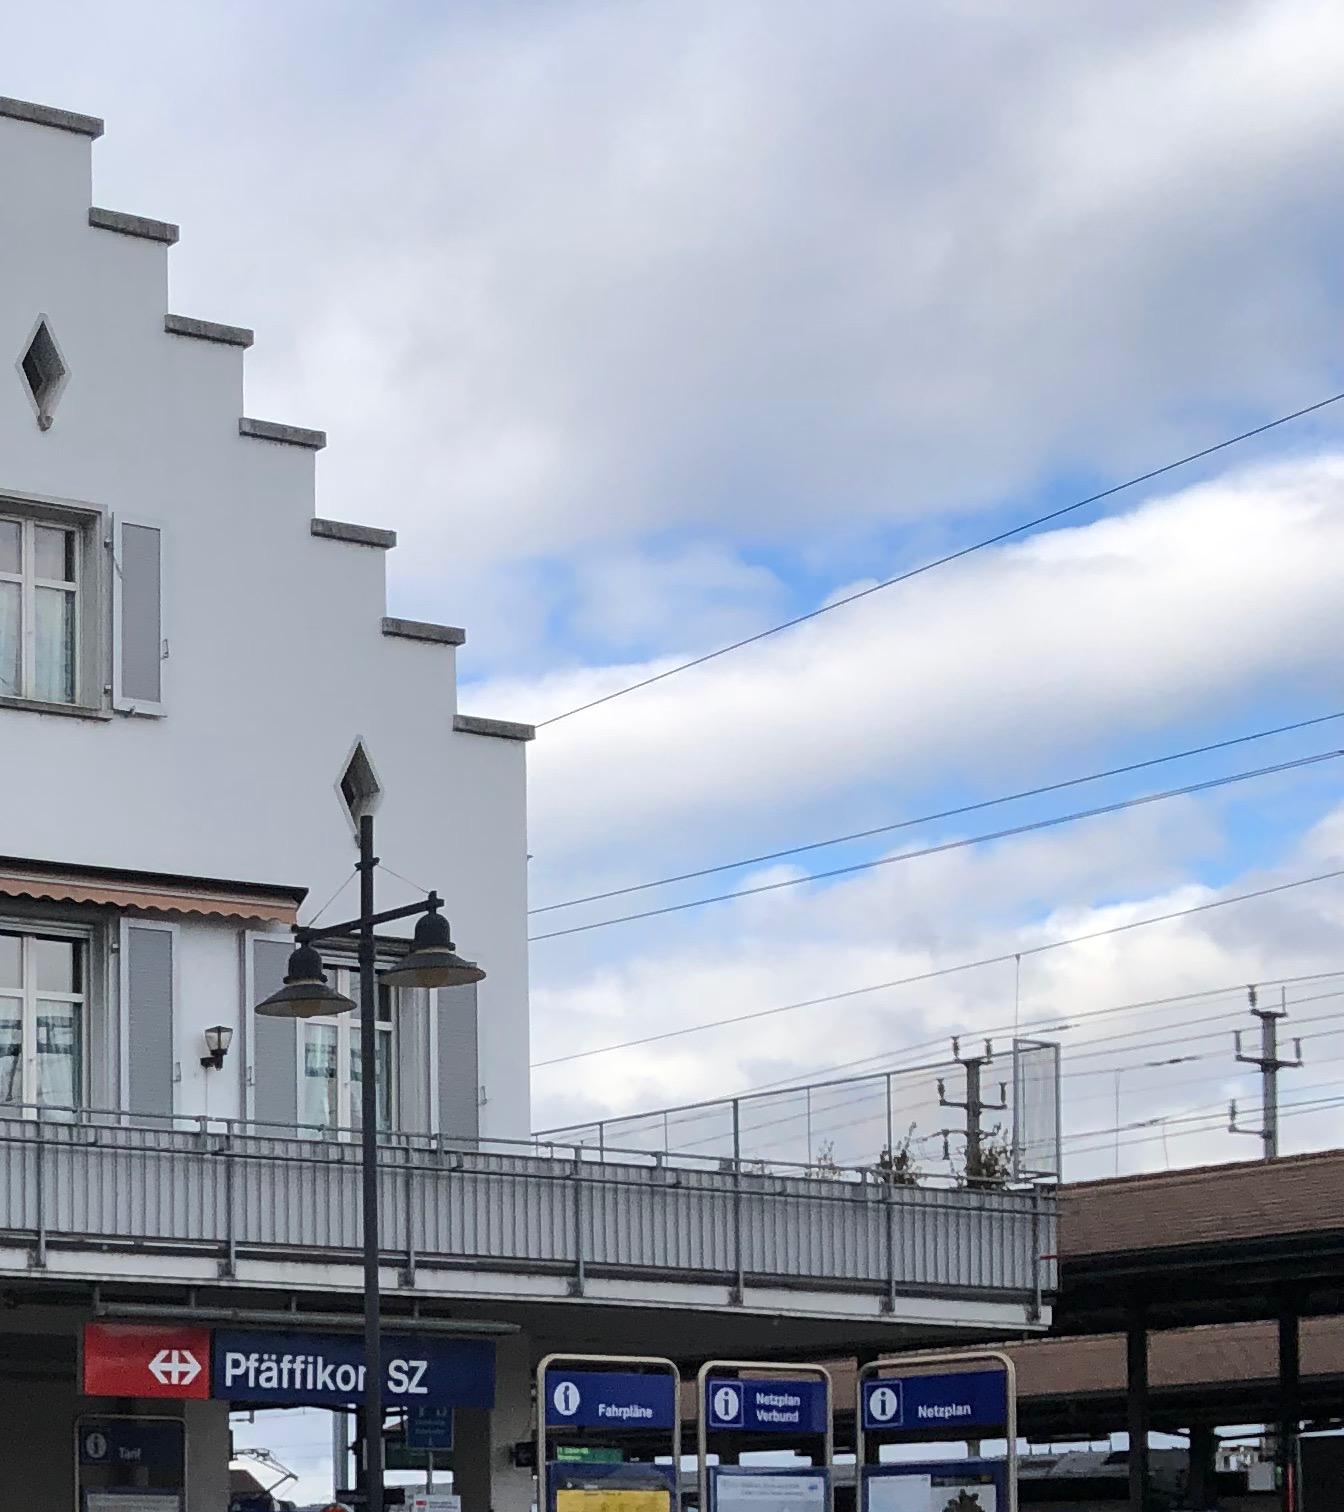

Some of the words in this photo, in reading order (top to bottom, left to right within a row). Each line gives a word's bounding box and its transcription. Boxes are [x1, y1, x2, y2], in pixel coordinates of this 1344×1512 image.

[388, 1359, 428, 1394] SZ
[756, 1392, 800, 1407] Netzplan
[598, 1403, 653, 1420] Fahrpläne
[756, 1409, 799, 1422] Verbund
[917, 1403, 972, 1419] Netzplan
[118, 1446, 142, 1461] Tarif
